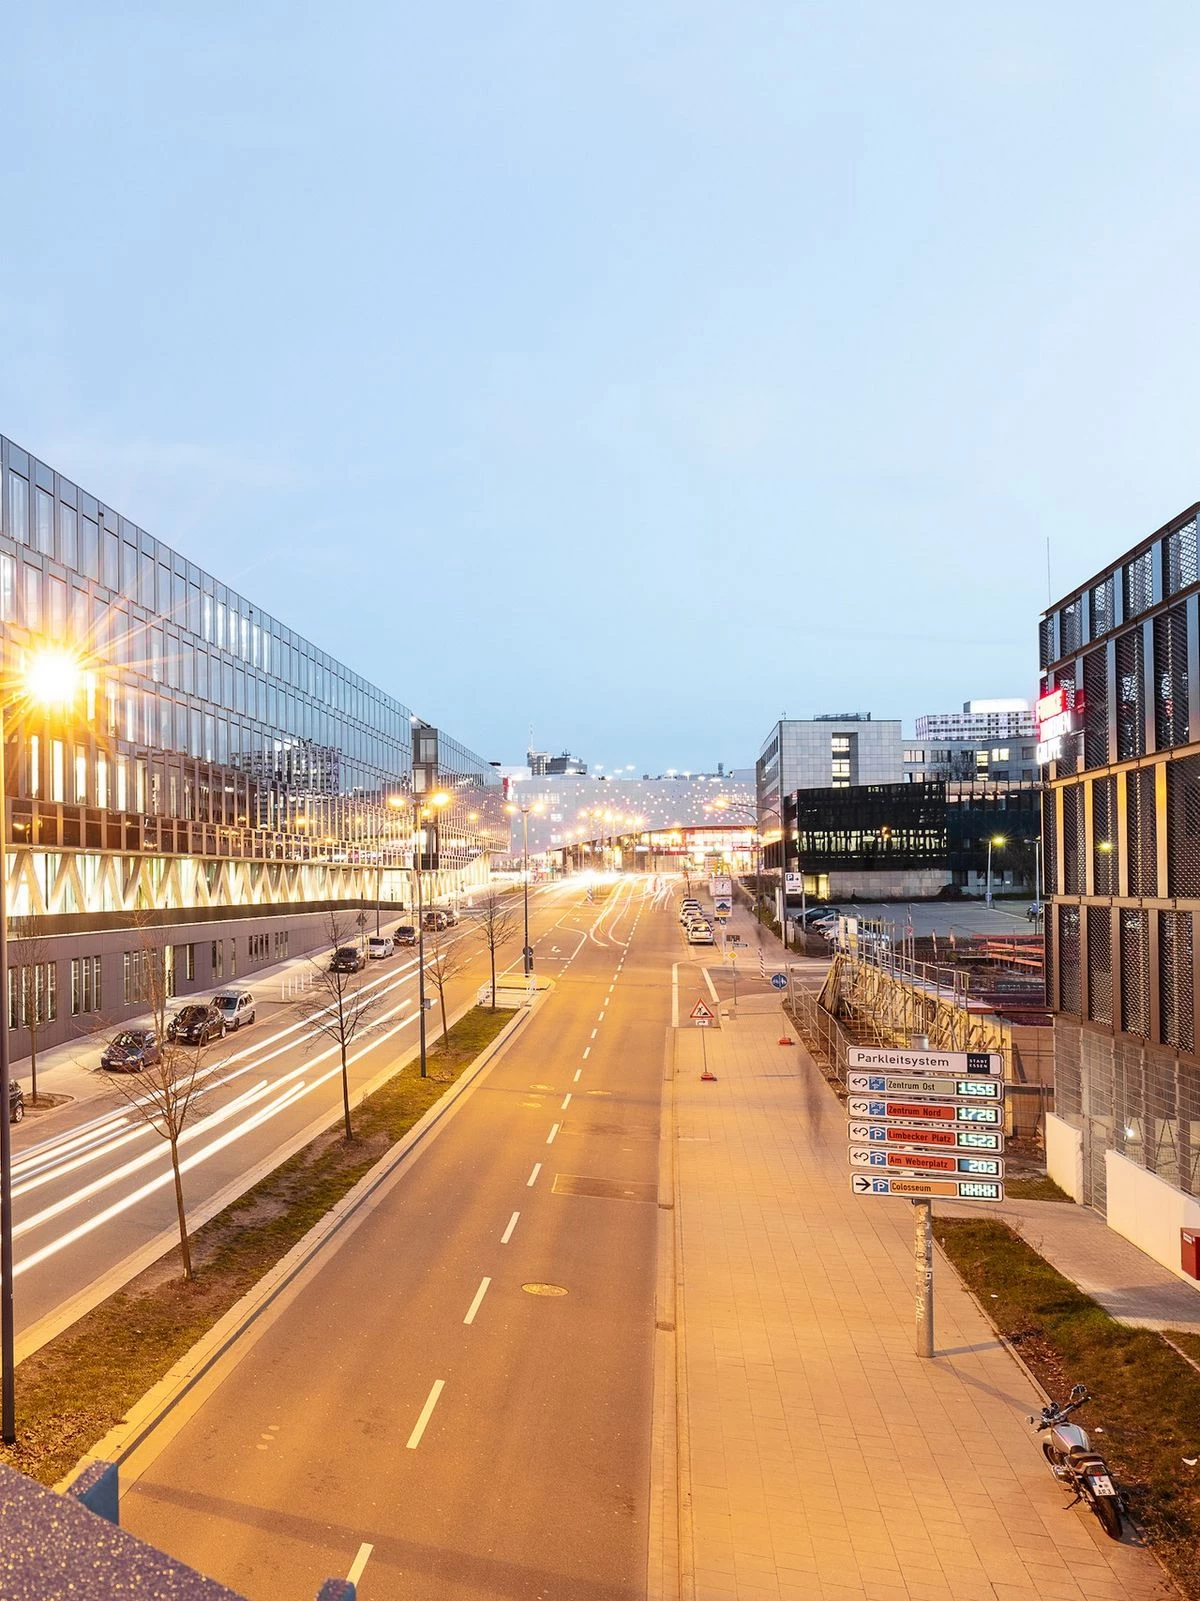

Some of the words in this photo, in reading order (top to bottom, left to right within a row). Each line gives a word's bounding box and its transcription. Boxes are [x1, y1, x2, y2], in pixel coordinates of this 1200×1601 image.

[857, 1053, 949, 1067] Parkleitsystem
[888, 1081, 920, 1090] Zentrum
[922, 1082, 935, 1091] Ost
[888, 1106, 920, 1115] Zentrum
[923, 1108, 941, 1116] Nord
[888, 1130, 928, 1141] Limbecker
[931, 1133, 951, 1143] Platz
[889, 1156, 902, 1164] Am
[905, 1157, 948, 1169] Weberplatz
[891, 1182, 932, 1192] Colosseum
